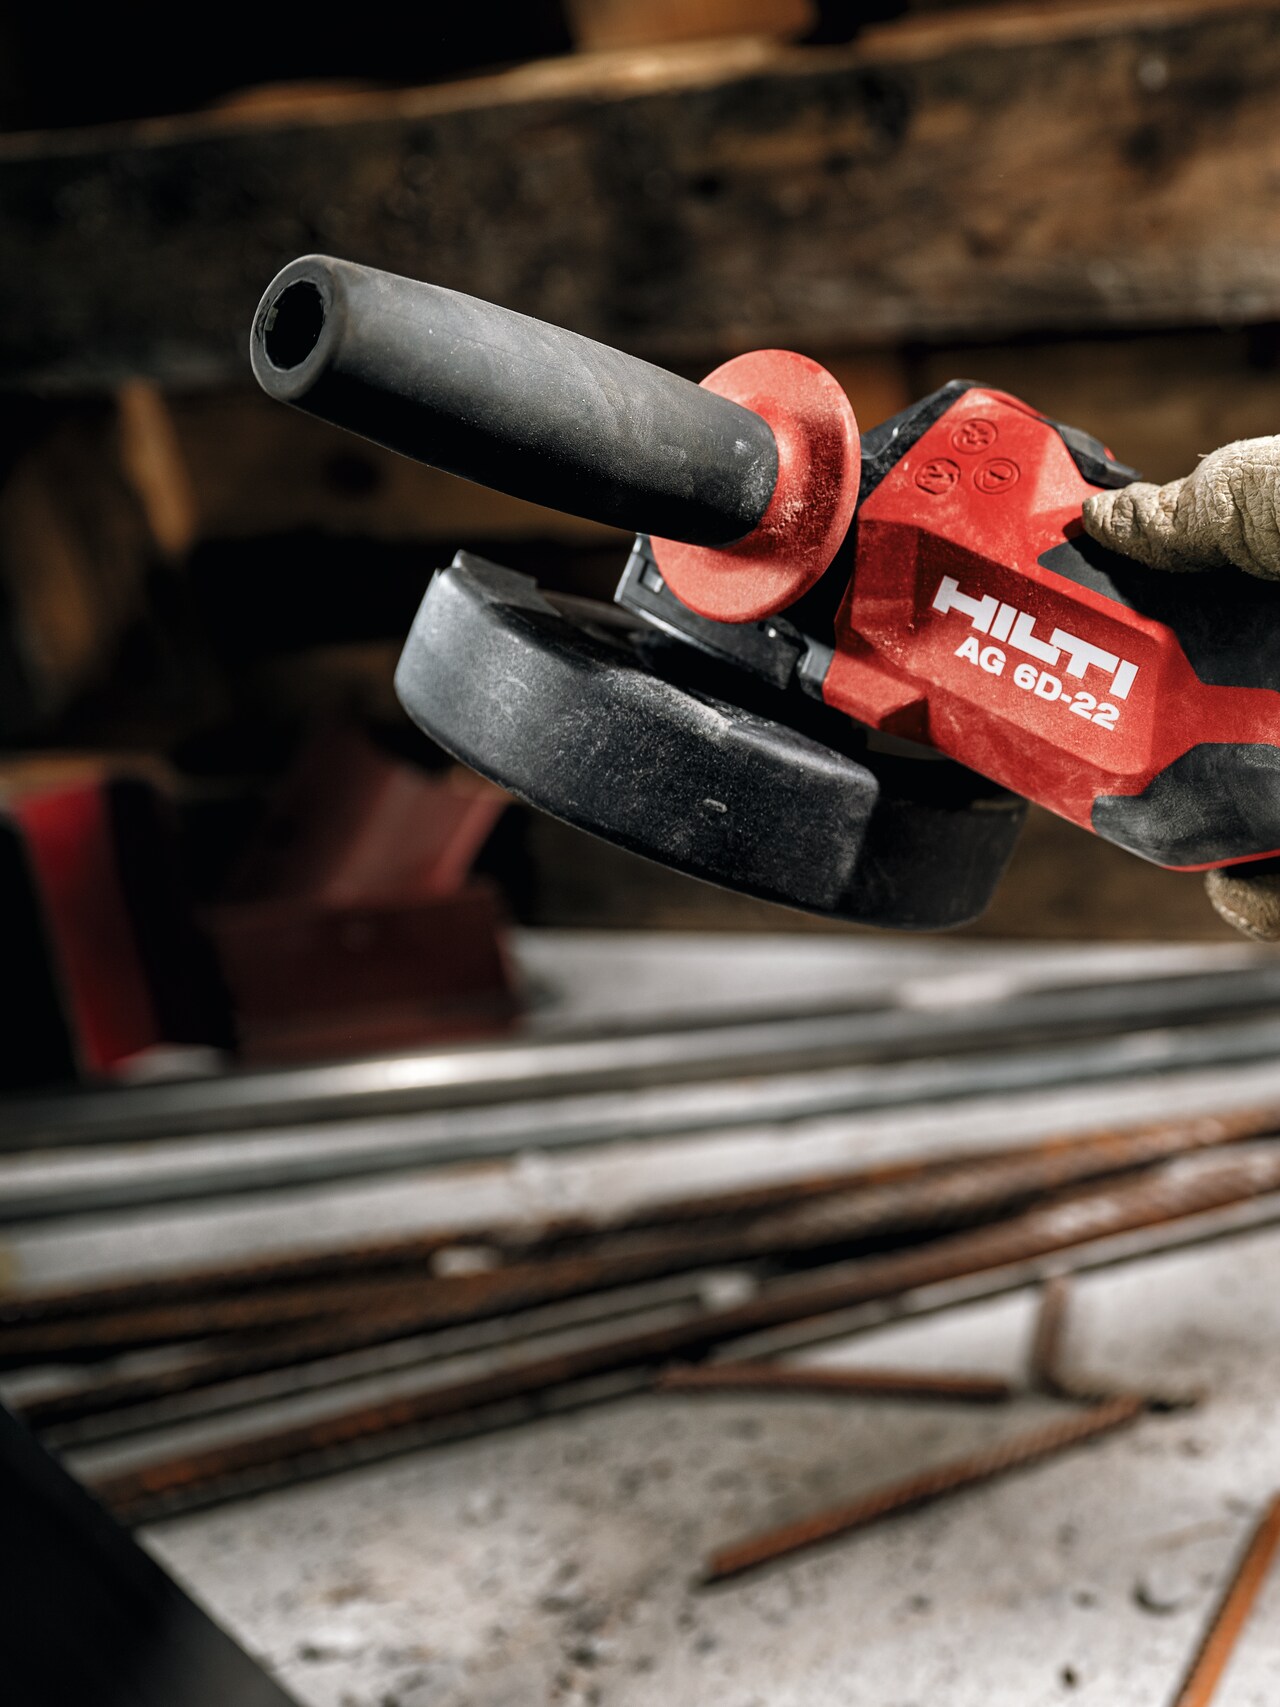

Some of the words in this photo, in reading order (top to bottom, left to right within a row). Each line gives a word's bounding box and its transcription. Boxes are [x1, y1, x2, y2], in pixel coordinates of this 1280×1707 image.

[932, 575, 1139, 700] HILTI
[954, 636, 1006, 676] AG
[1013, 663, 1121, 731] 6D-22
